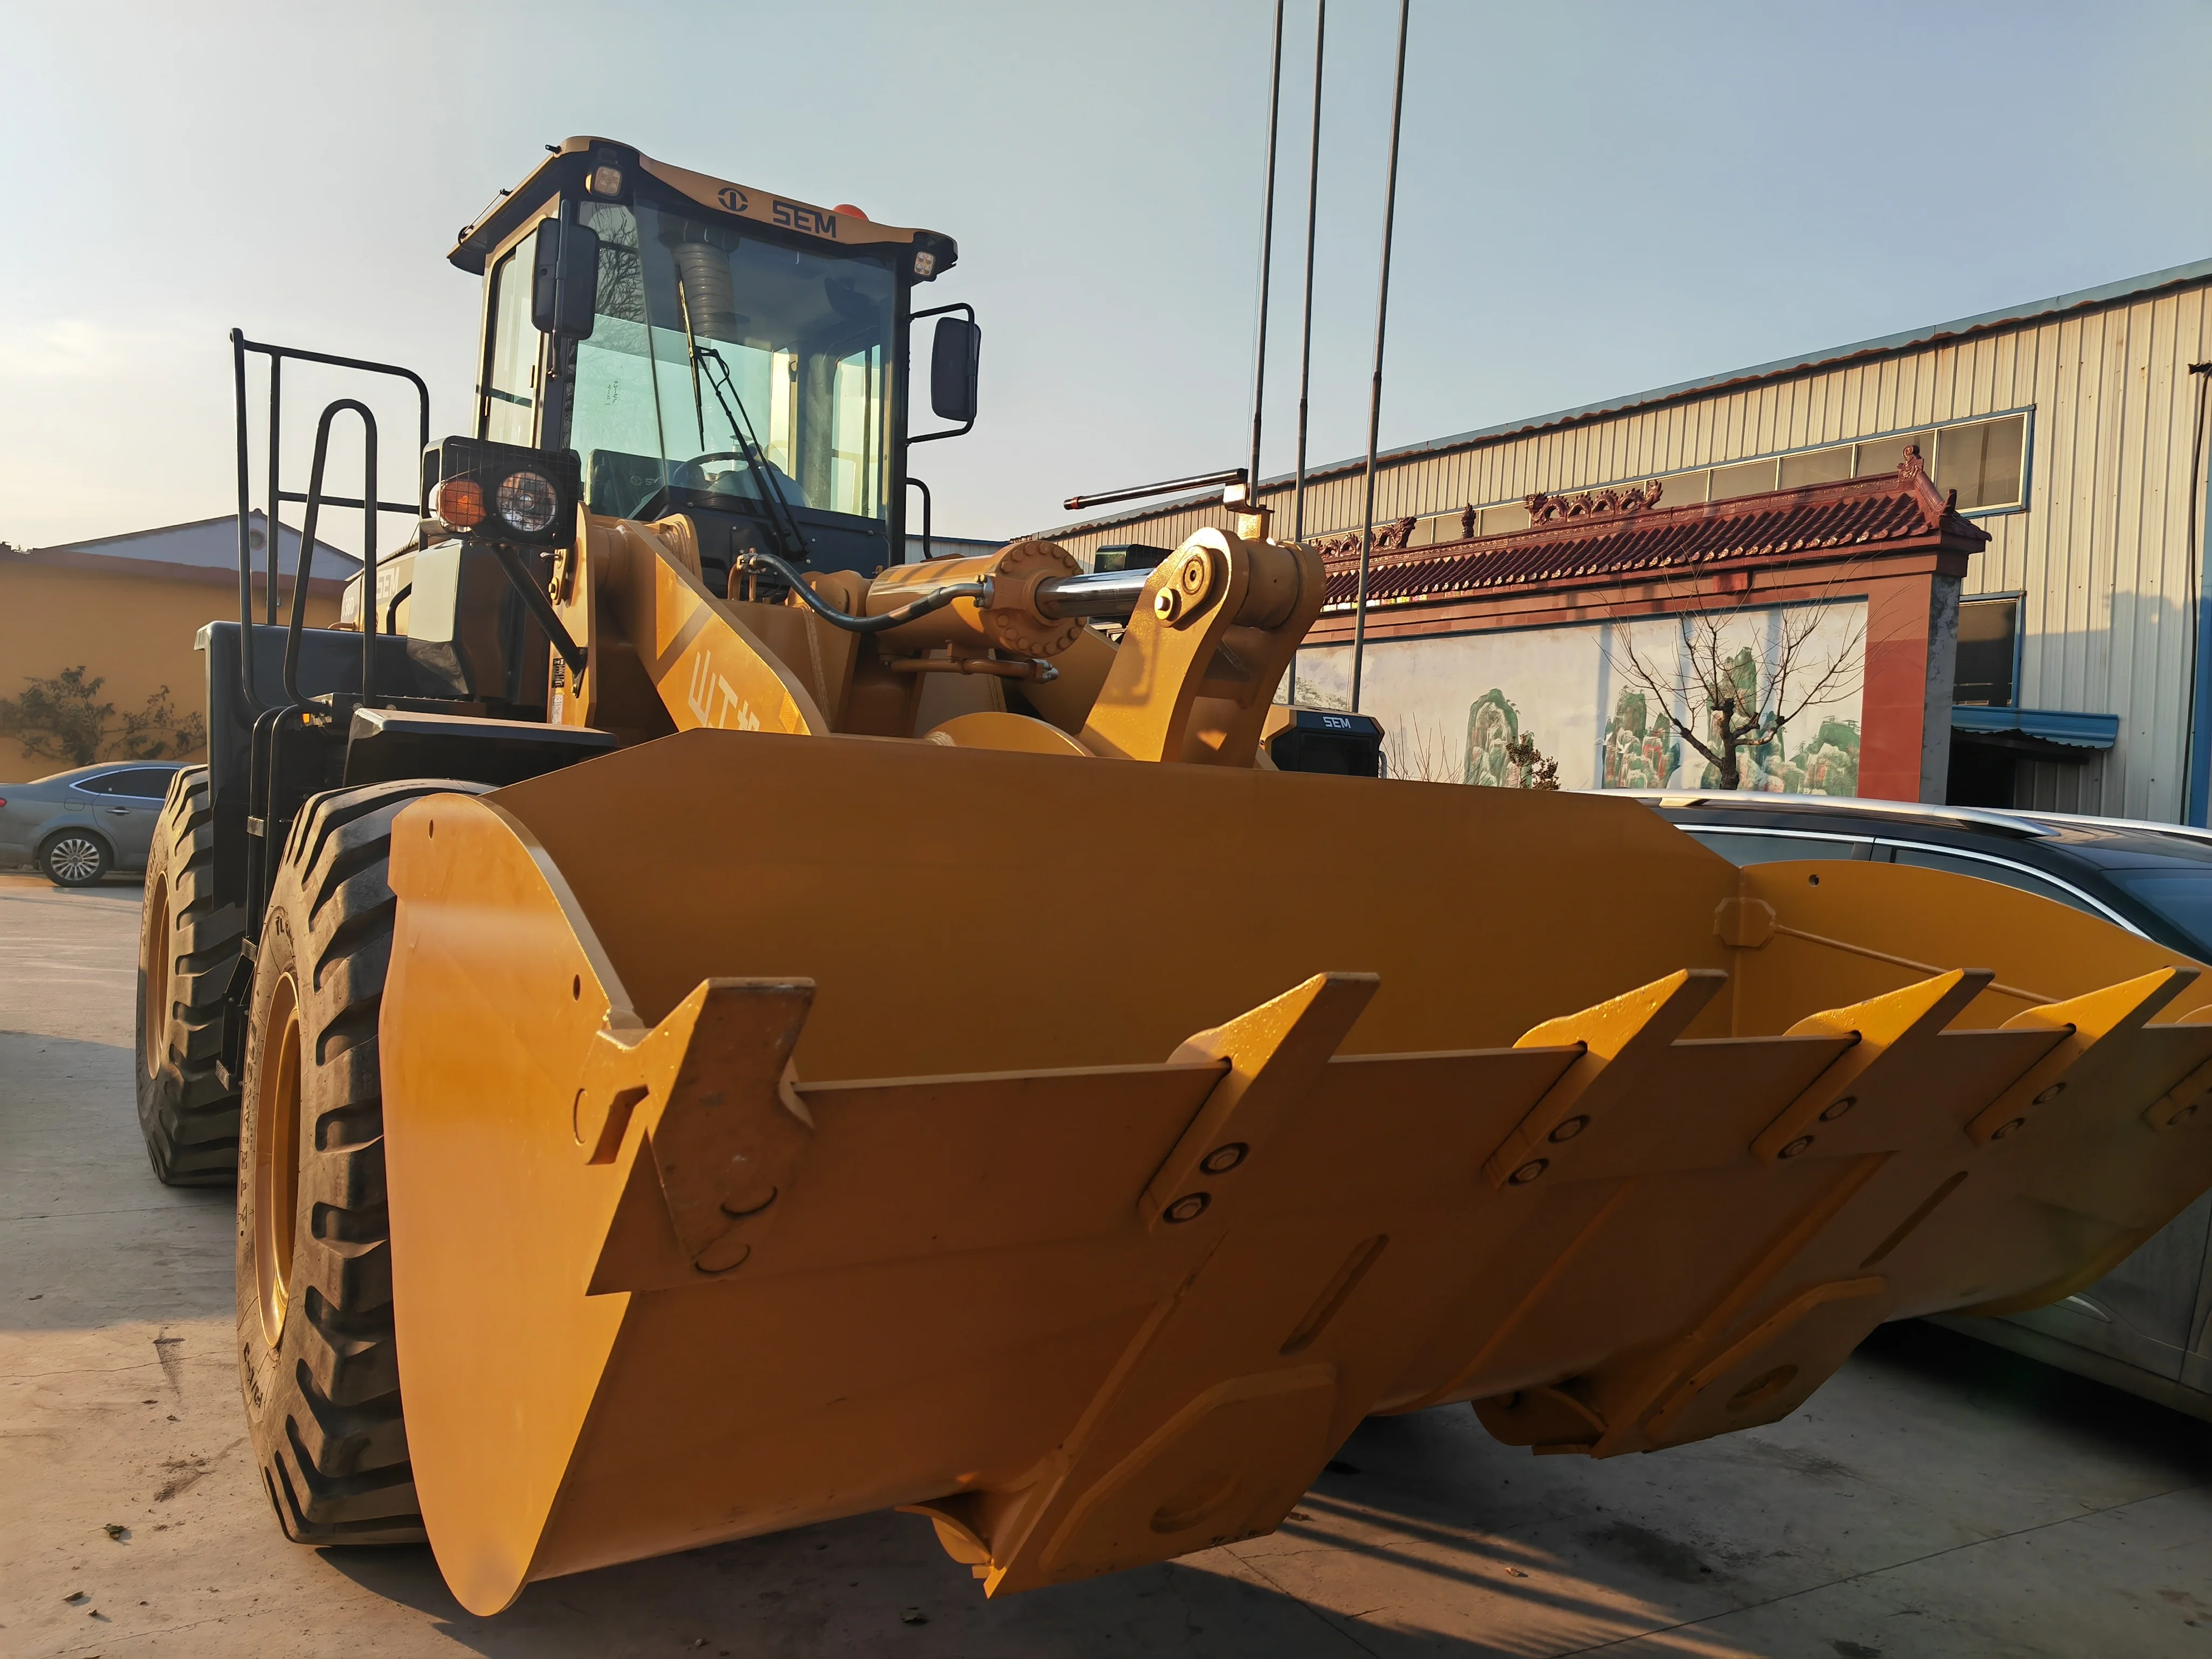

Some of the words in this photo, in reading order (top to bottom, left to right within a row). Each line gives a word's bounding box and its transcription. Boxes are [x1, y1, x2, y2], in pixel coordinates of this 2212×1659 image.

[773, 200, 836, 238] SEM
[376, 566, 400, 599] SEM
[1323, 716, 1351, 729] SEM
[240, 1022, 257, 1197] TRIANGLE
